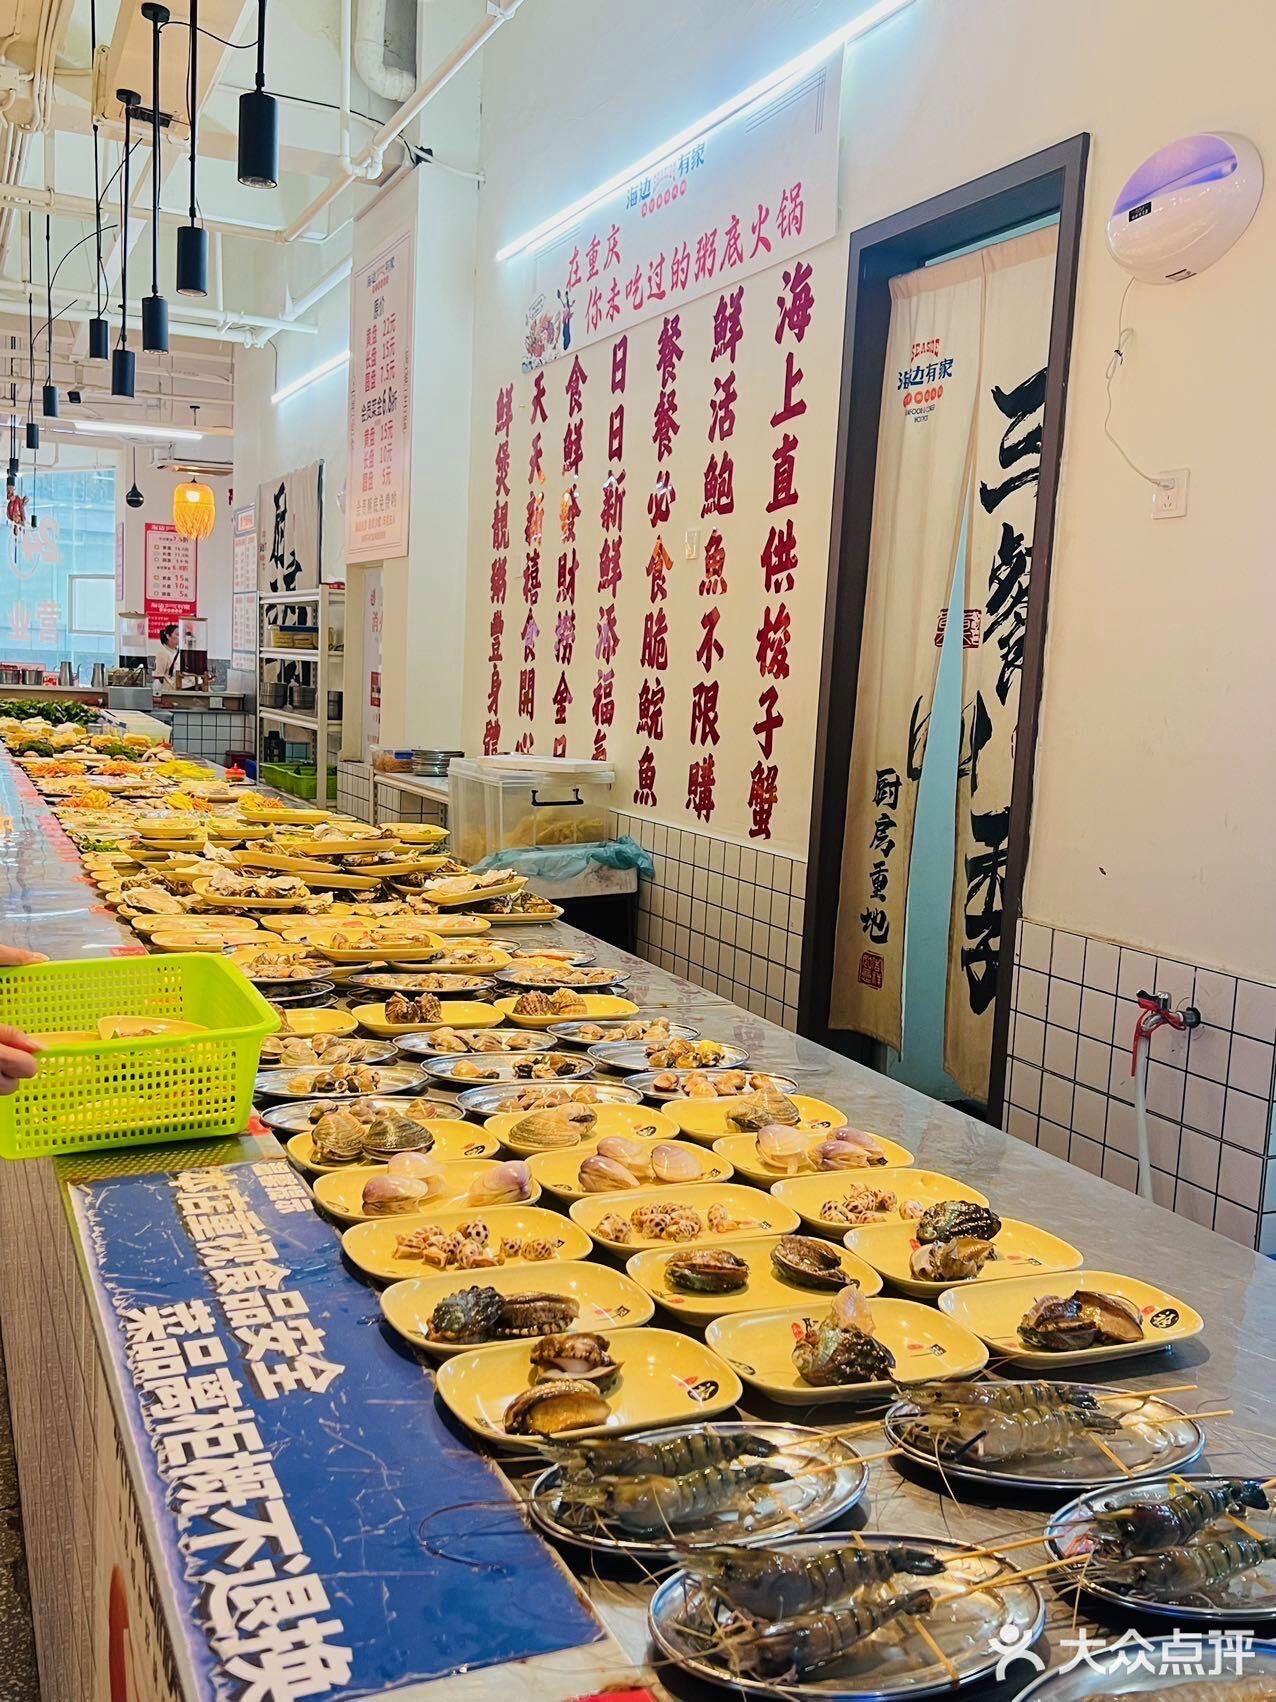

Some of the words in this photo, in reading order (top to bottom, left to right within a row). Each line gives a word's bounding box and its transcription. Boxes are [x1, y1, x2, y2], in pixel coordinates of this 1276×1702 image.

[566, 223, 622, 290] 在重庆
[585, 181, 804, 334] 你未吃过的粥底火锅
[685, 286, 744, 823] 鮮活鮑魚不限購
[748, 262, 814, 840] 海上直供梭子蟹
[860, 767, 902, 944] 厨房重地
[168, 1170, 345, 1400] 本店重视食品安全
[121, 1299, 353, 1702] 菜品离柜概不退换
